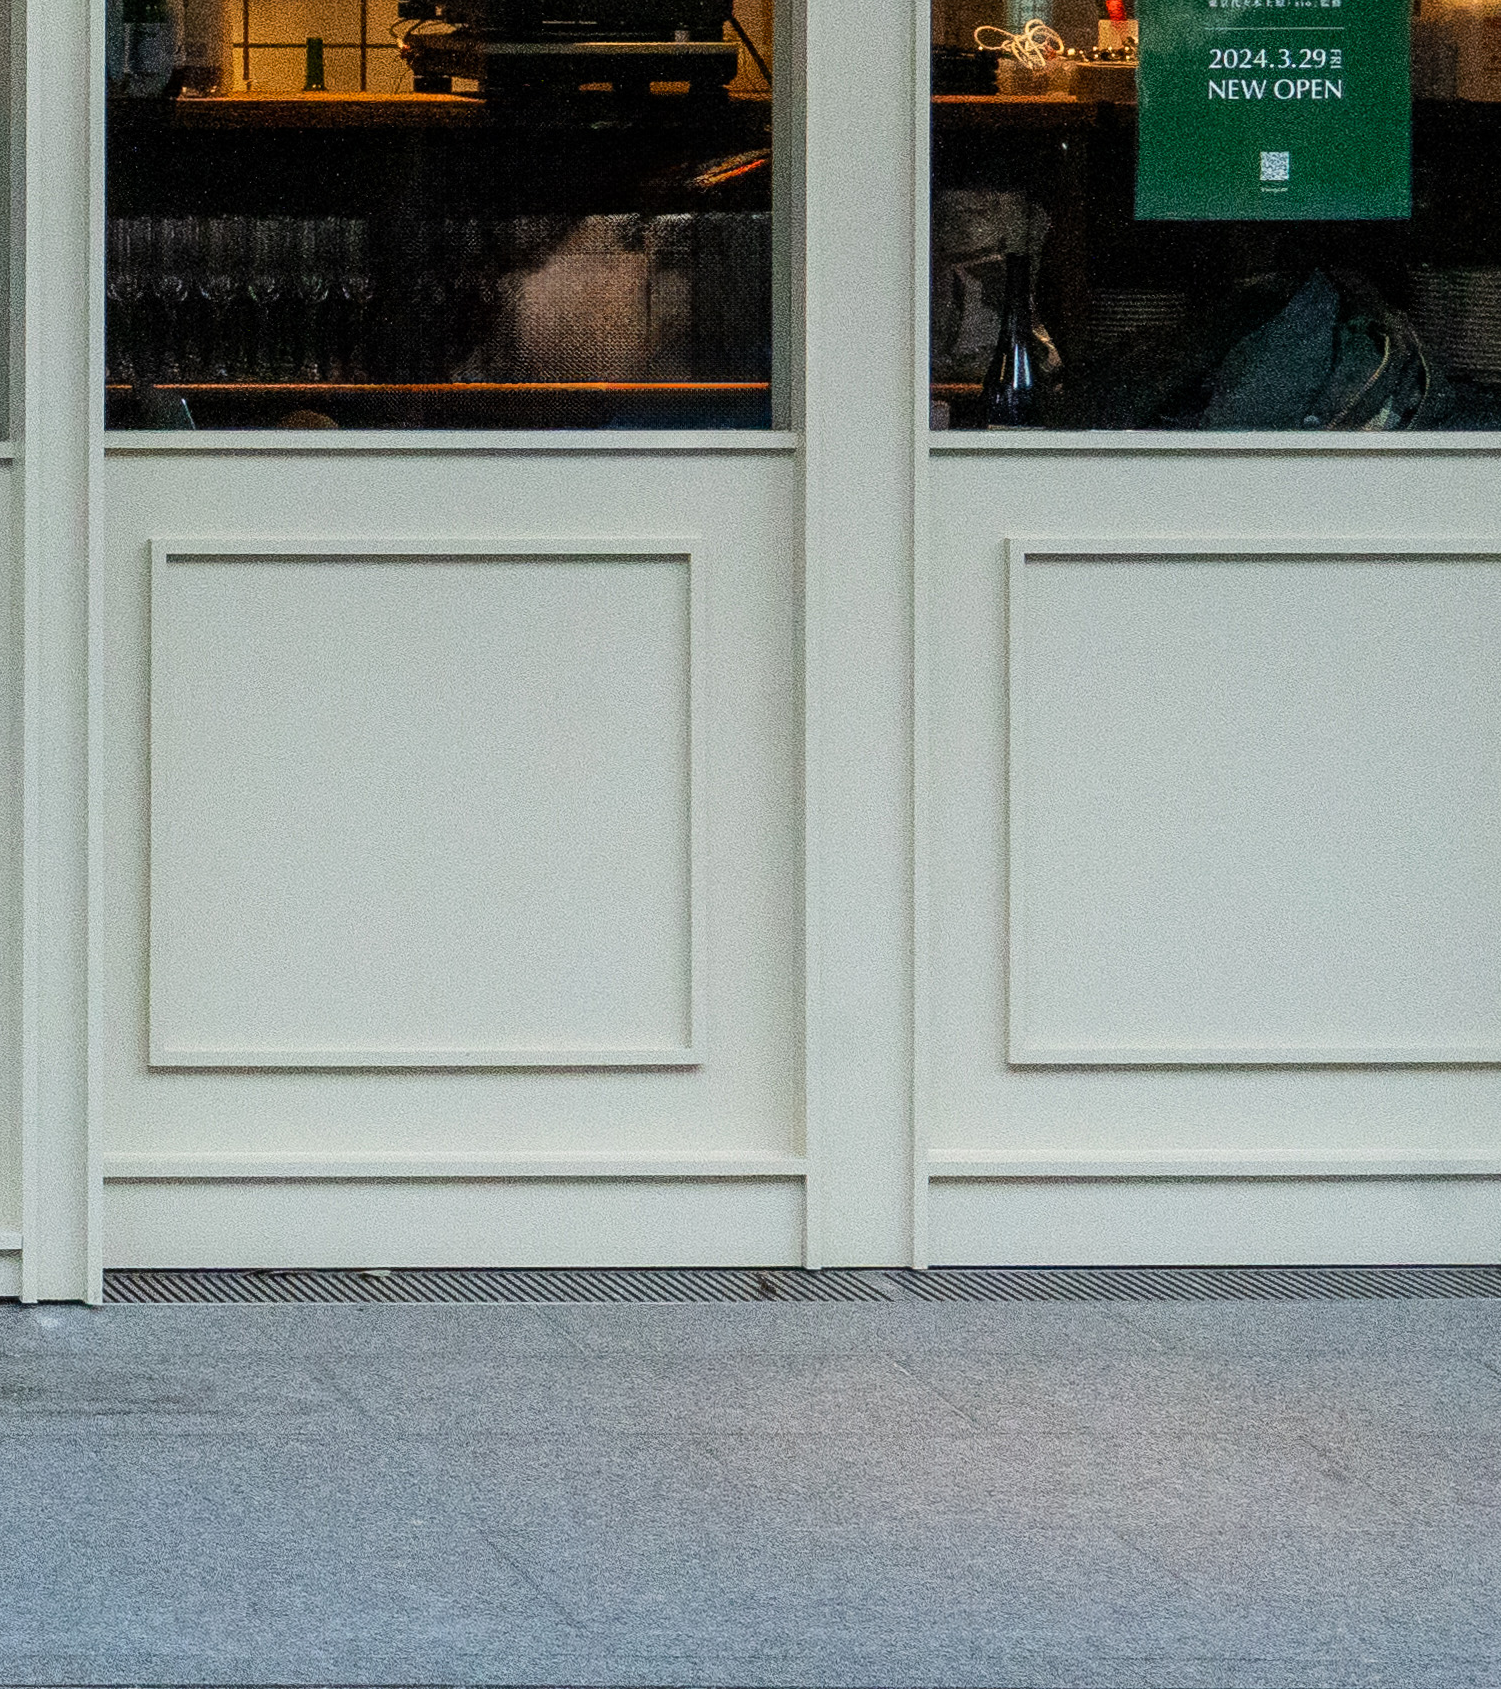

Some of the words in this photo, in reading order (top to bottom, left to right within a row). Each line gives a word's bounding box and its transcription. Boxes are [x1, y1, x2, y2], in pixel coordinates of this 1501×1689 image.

[1209, 48, 1327, 69] 2024.3.29
[1331, 49, 1343, 69] FRI
[1208, 79, 1267, 100] NEW
[1273, 79, 1342, 99] OPEN
